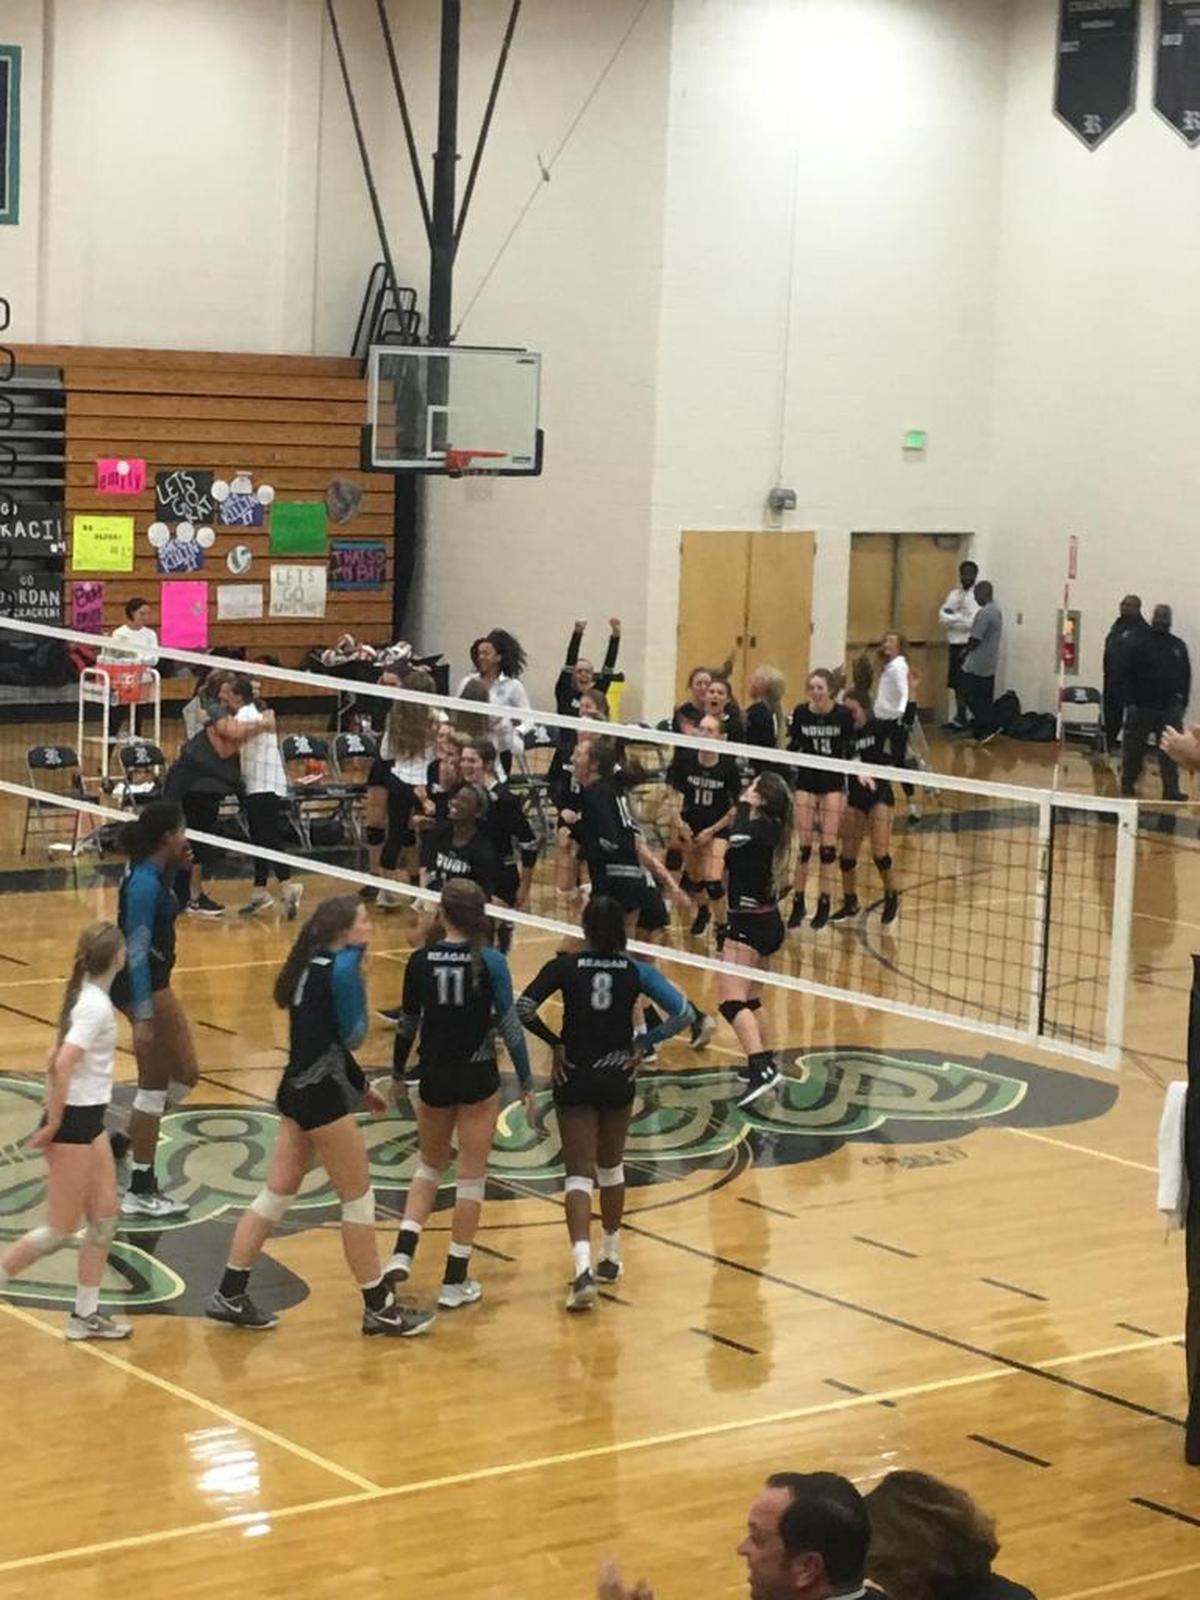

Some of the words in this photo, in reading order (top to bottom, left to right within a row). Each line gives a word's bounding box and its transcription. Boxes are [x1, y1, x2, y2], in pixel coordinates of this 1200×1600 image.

[156, 470, 196, 505] LETS
[276, 569, 315, 586] LETS
[283, 585, 305, 602] GO
[577, 958, 628, 969] REAGAN
[432, 966, 464, 1005] 11
[591, 972, 613, 1010] 8
